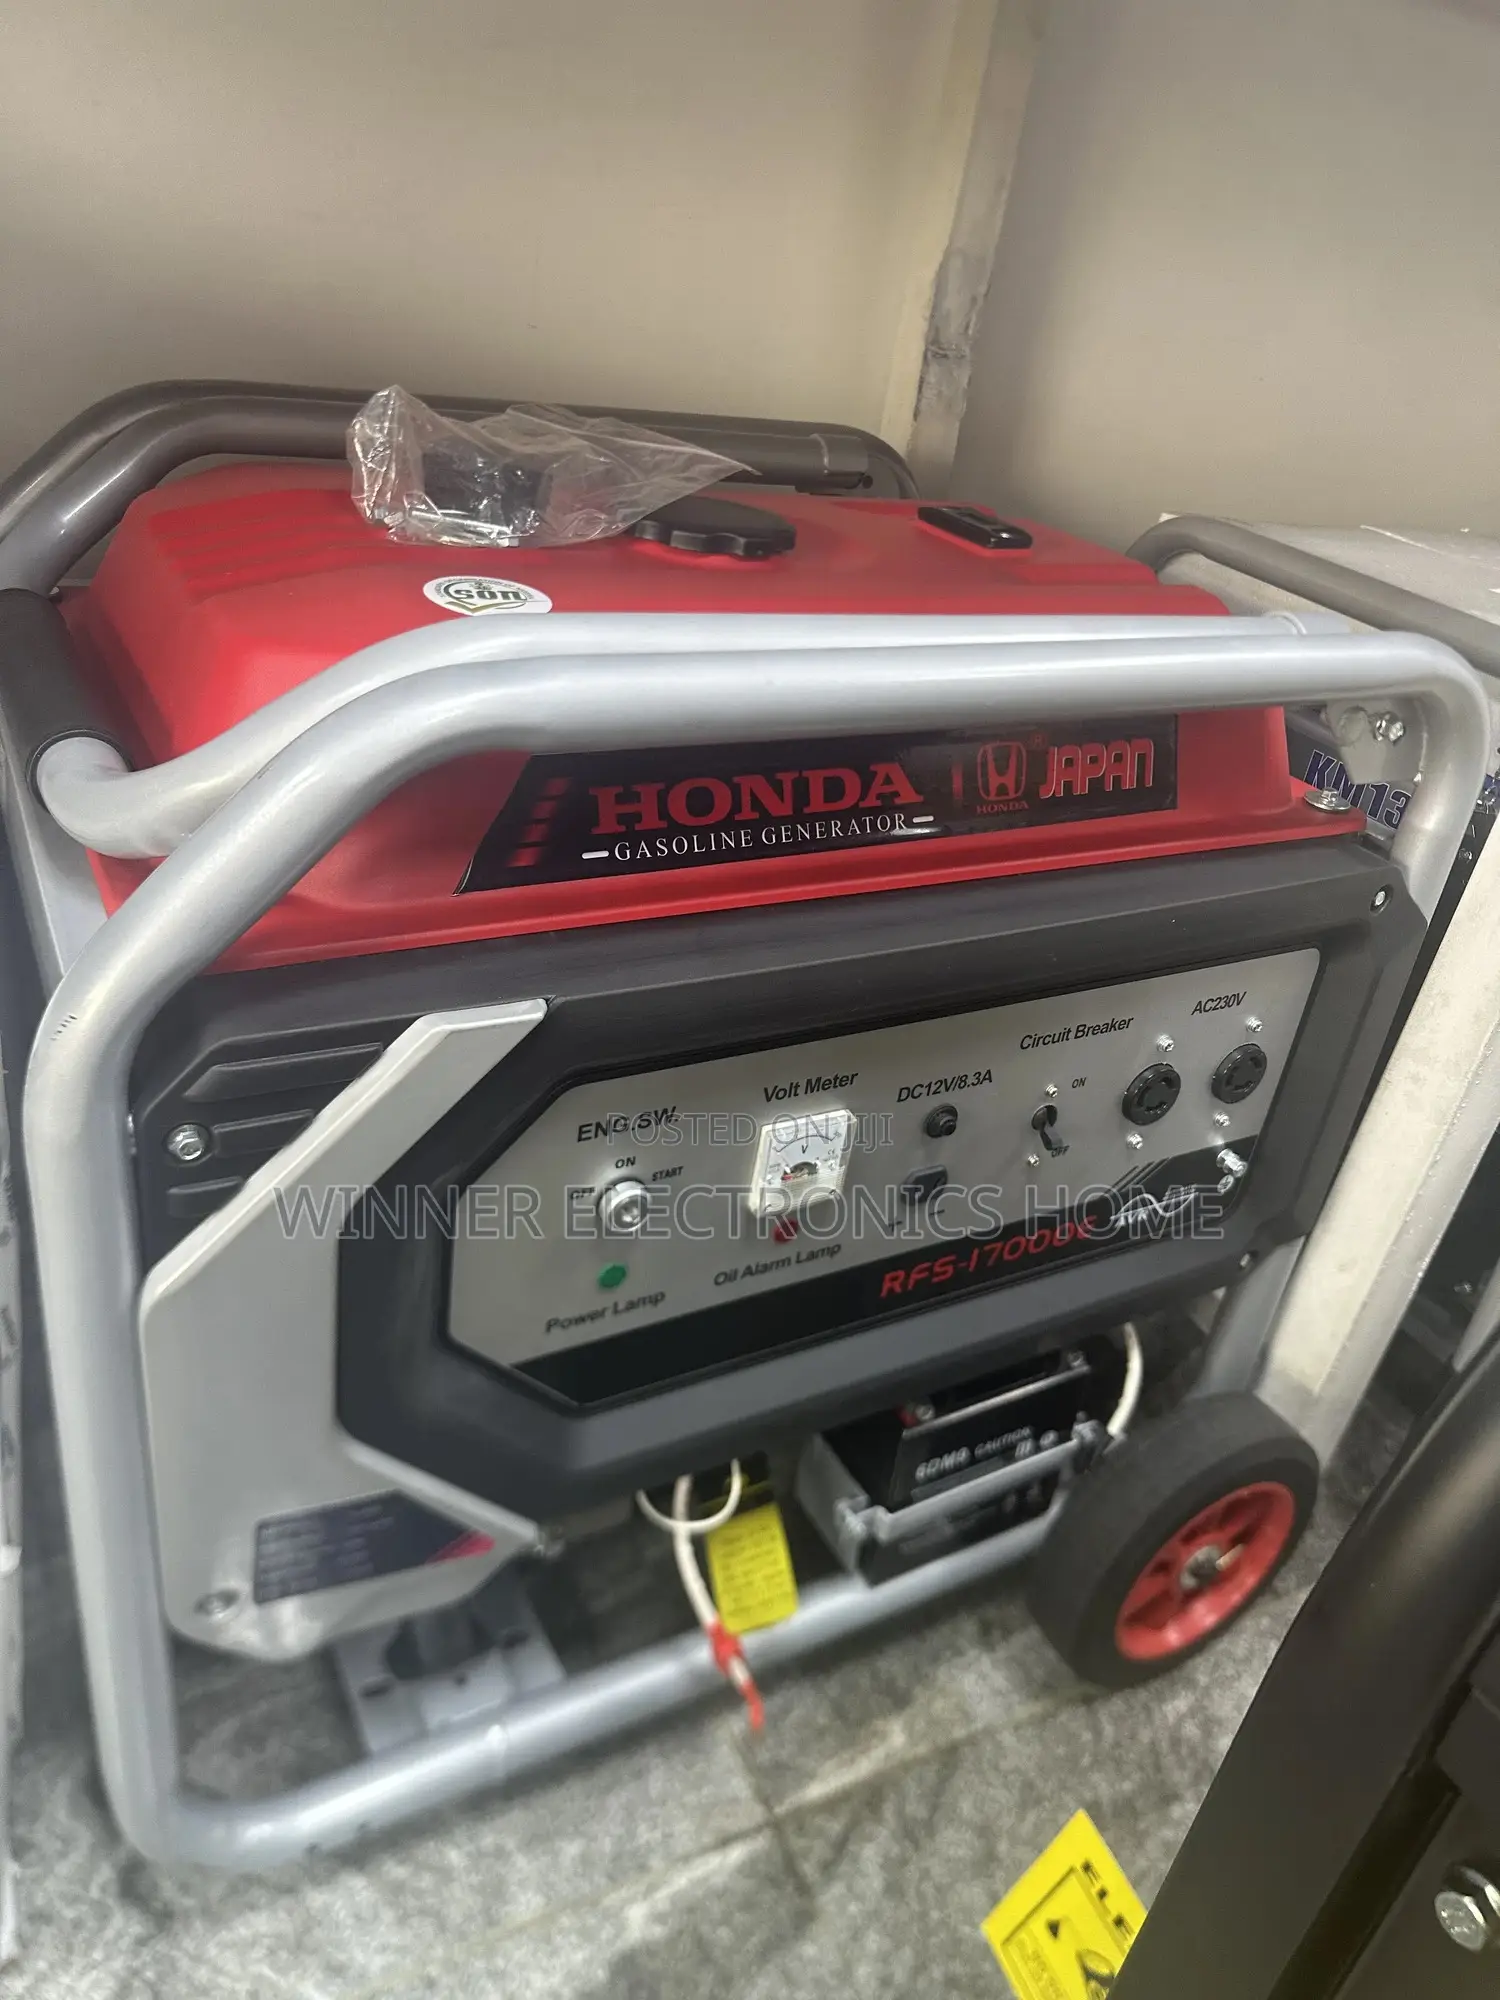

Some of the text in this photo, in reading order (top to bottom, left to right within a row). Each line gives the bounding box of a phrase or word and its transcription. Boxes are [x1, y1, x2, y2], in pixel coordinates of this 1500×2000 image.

[1039, 738, 1154, 799] JAPAN
[589, 762, 924, 835] HONDA
[976, 800, 1030, 815] HONDA
[614, 812, 907, 861] GASOLINE GENERATOR
[1190, 991, 1248, 1016] AC230V
[1019, 1015, 1135, 1051] Circuit Breaker
[763, 1071, 859, 1103] Volt Meter
[896, 1068, 994, 1104] DC12V/8.3A
[1071, 1076, 1087, 1090] ON
[615, 1155, 637, 1169] ON
[652, 1165, 684, 1182] START
[570, 1187, 596, 1201] OFF
[713, 1242, 842, 1287] Oil Alarm Lamp
[545, 1290, 667, 1334] Power Lamp
